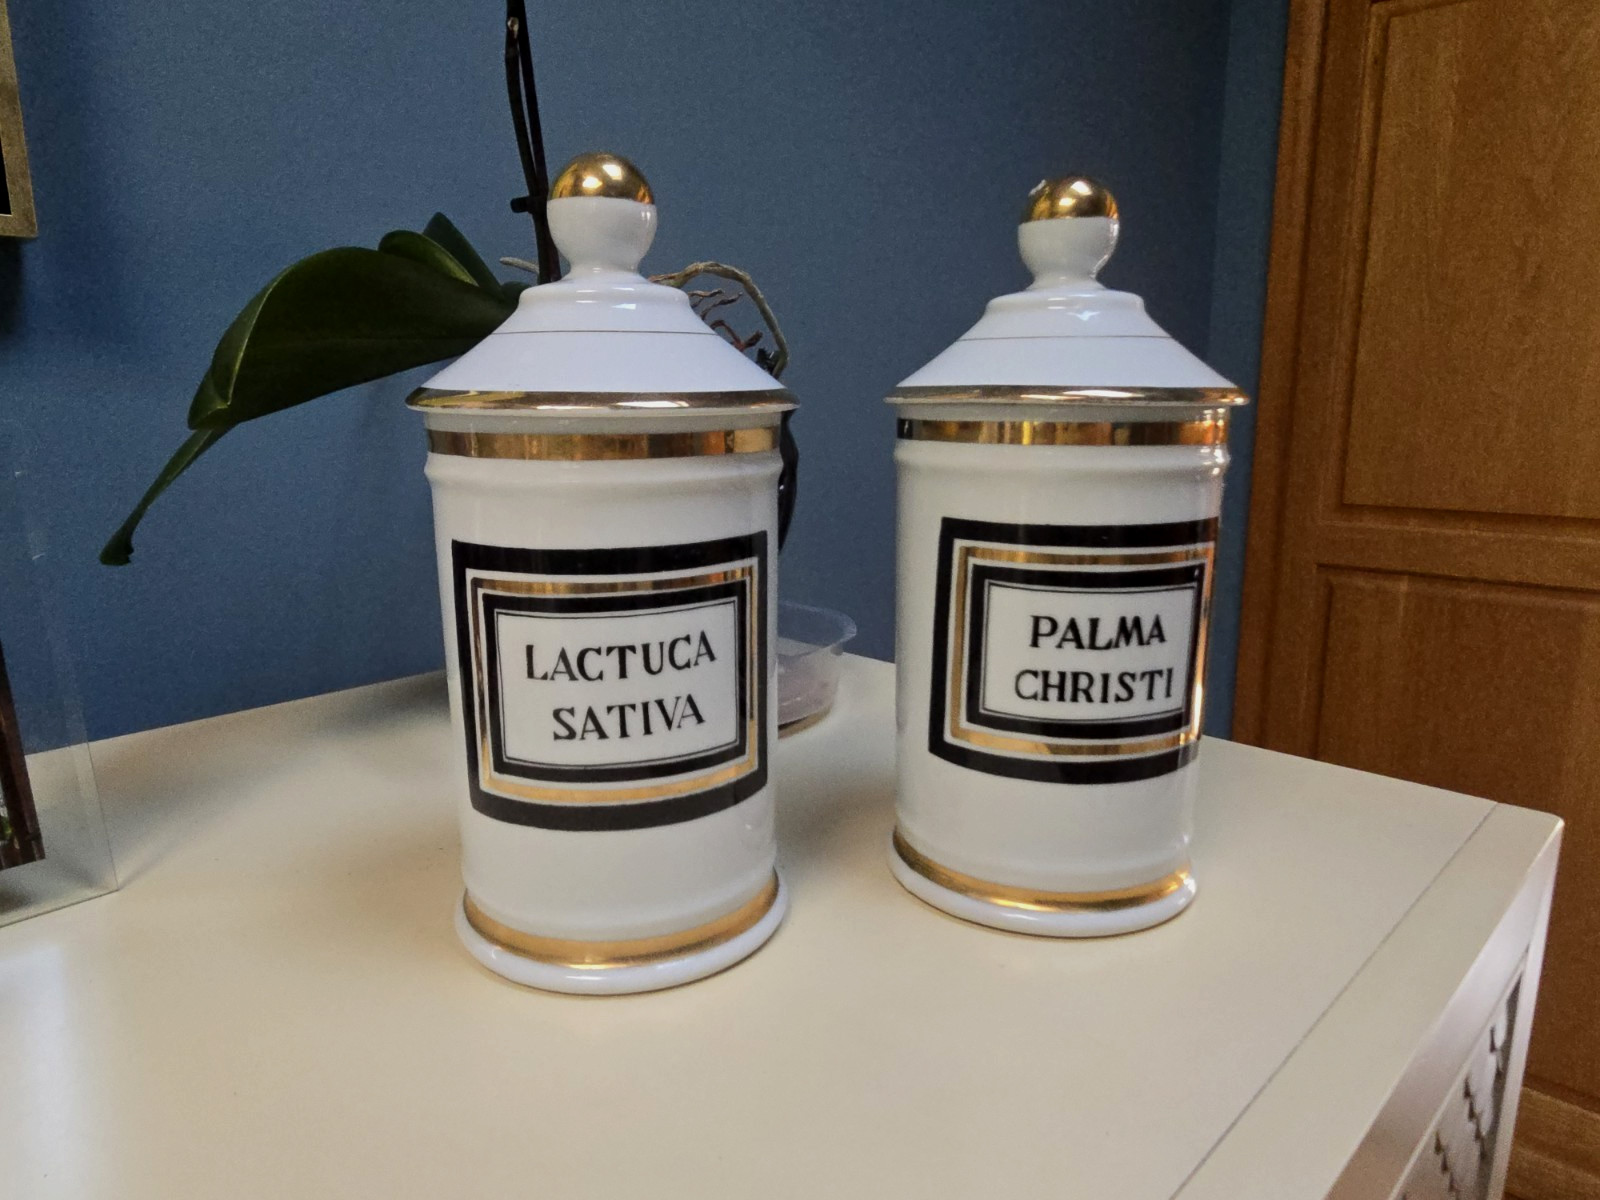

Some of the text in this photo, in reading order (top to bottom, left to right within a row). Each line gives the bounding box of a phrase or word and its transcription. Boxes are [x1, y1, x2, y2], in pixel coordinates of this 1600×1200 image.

[1029, 613, 1167, 650] PALMA
[525, 629, 717, 682] LACTUCA
[1014, 667, 1174, 704] CHRISTI
[552, 693, 706, 741] SATIVA
